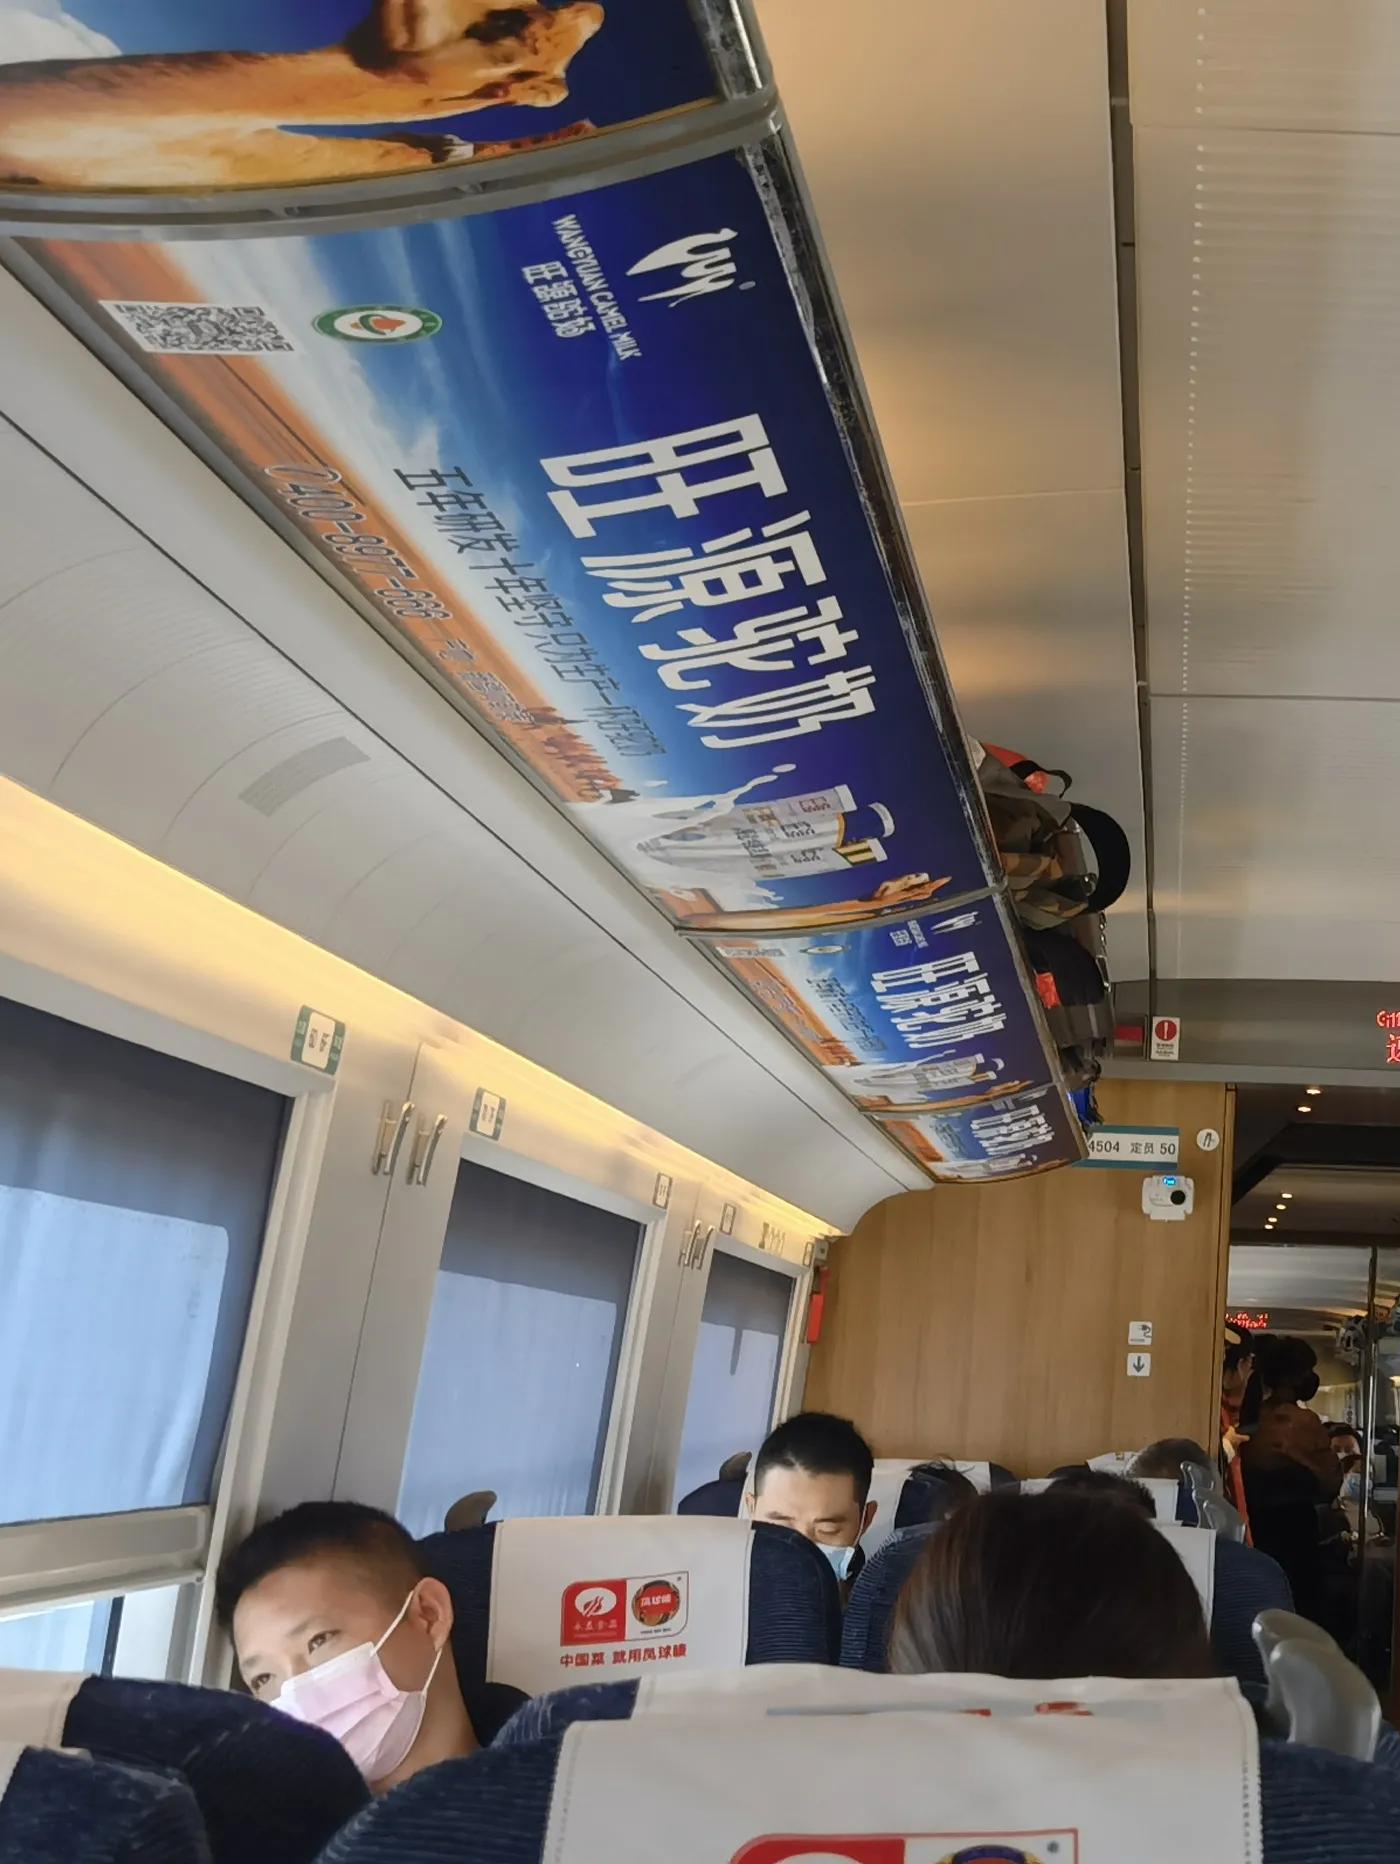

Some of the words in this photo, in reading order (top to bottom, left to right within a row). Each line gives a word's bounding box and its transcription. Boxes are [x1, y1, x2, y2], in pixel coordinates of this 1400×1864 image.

[551, 214, 608, 292] WANGYUAN
[521, 260, 596, 339] 旺源驼奶
[589, 290, 628, 335] CAMEL
[608, 330, 642, 361] MILK
[539, 413, 876, 749] 旺源驼奶
[1129, 1142, 1154, 1154] 定员
[1159, 1143, 1176, 1155] 50
